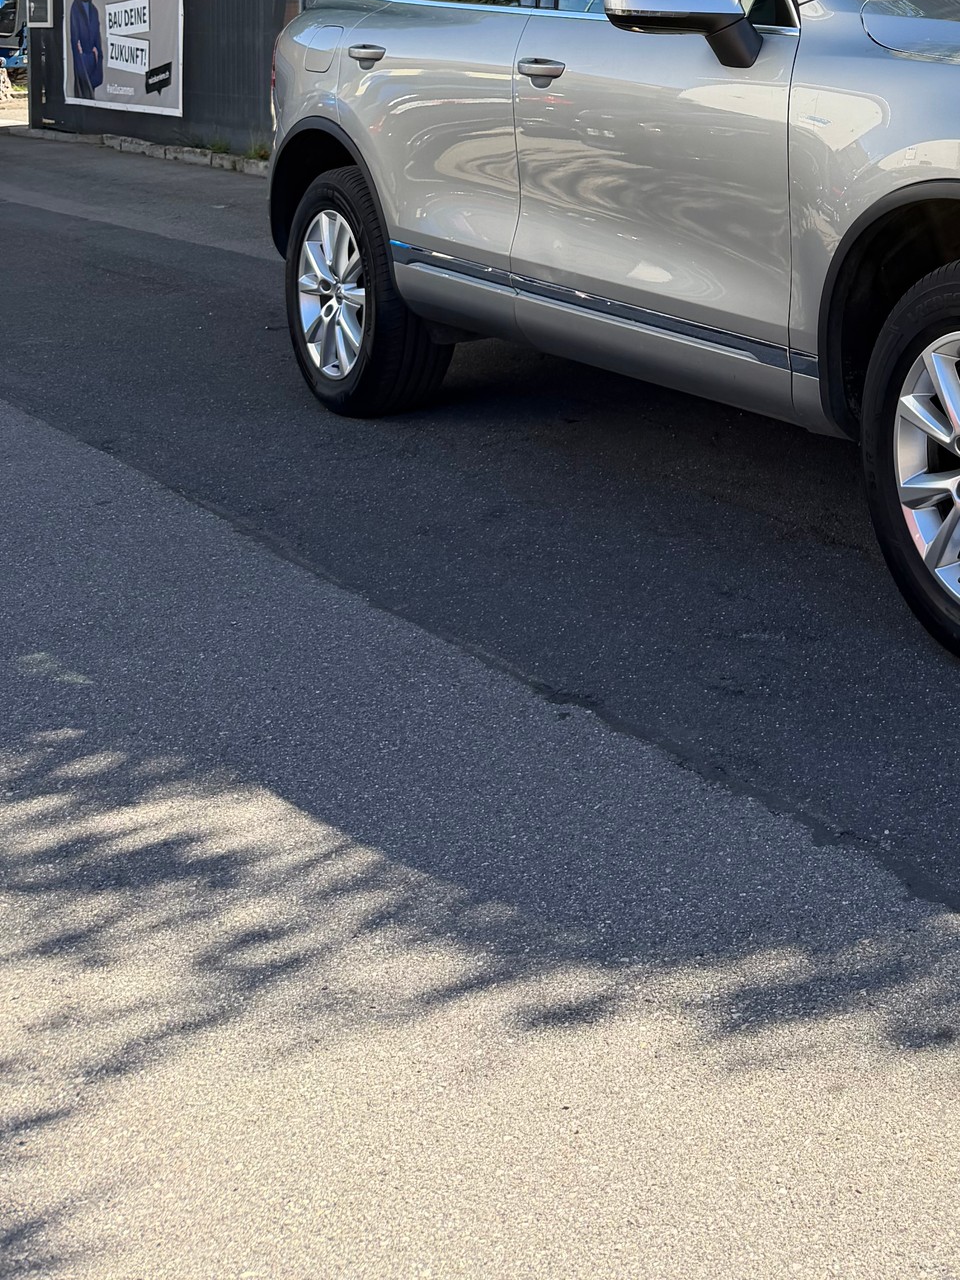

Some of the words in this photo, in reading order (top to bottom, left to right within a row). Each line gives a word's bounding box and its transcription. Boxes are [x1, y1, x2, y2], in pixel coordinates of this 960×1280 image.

[108, 10, 123, 30] BAU
[124, 6, 147, 27] DEINE
[110, 42, 147, 67] ZUKUNFT!
